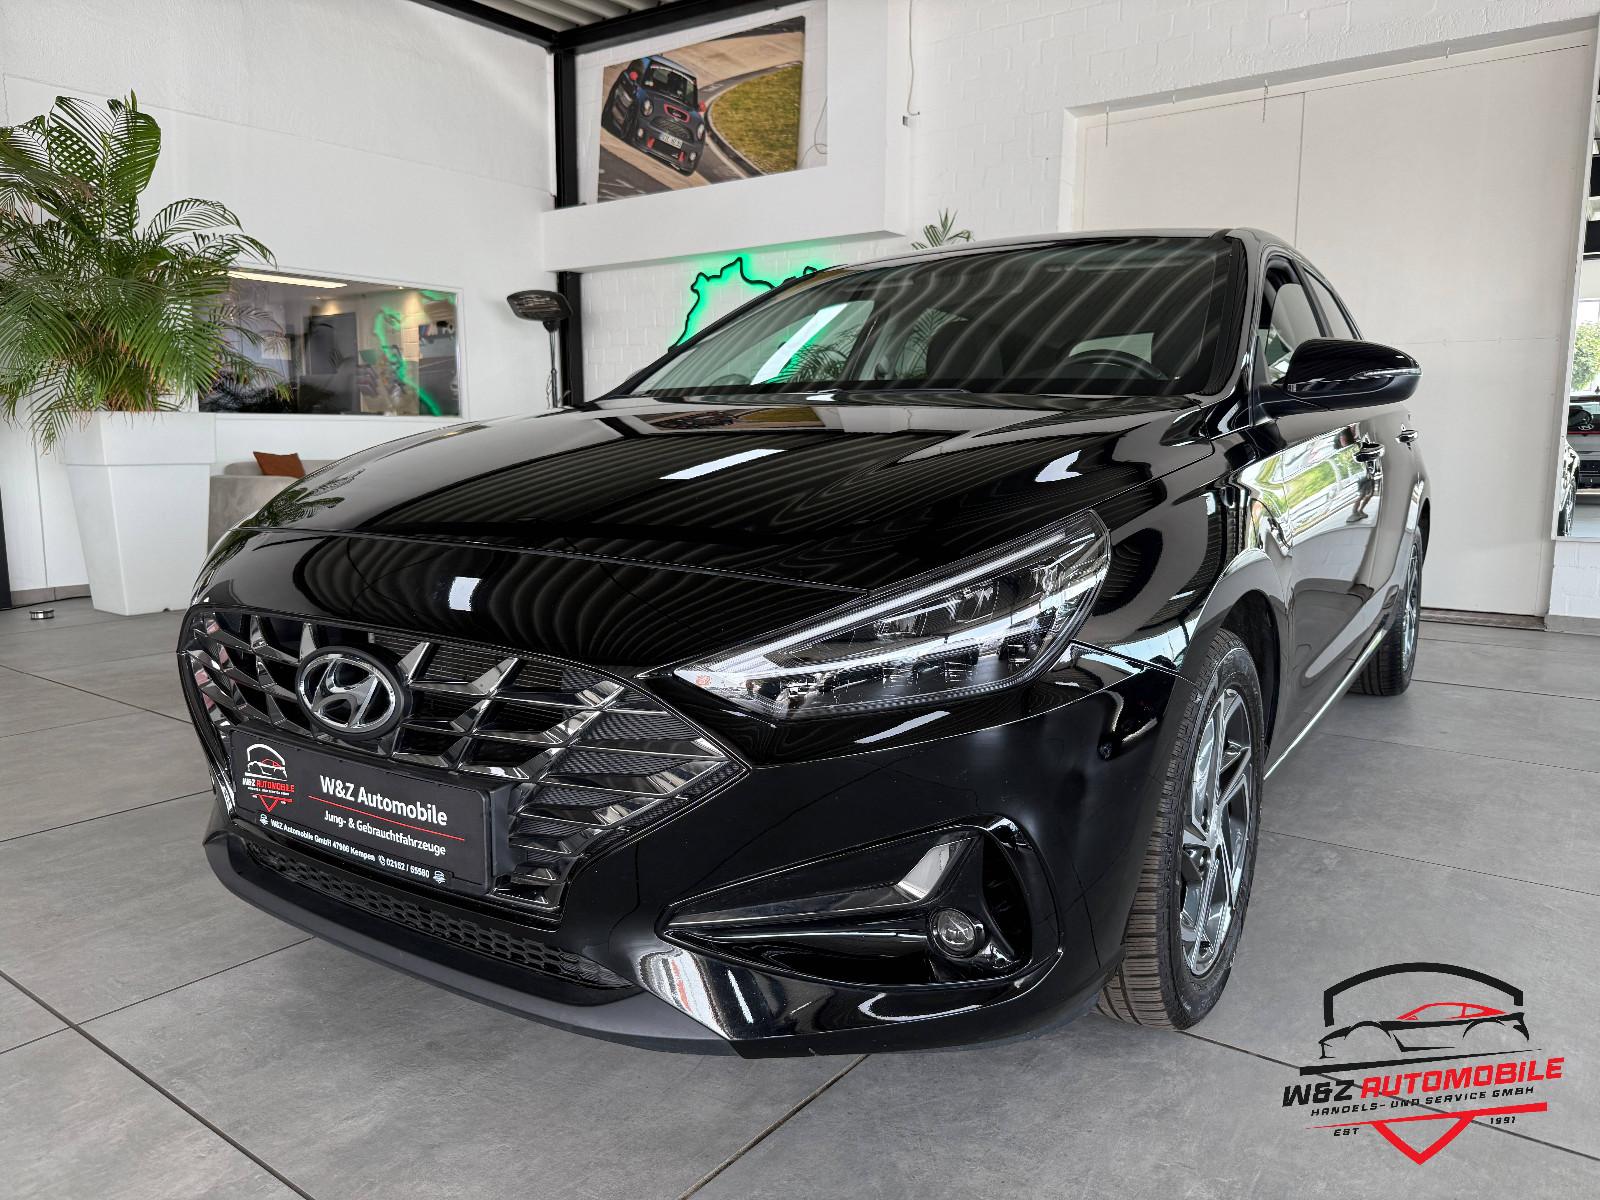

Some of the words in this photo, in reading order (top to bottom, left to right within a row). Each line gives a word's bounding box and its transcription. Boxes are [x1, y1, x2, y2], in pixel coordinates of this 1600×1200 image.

[319, 774, 355, 801] W&Z
[357, 786, 448, 826] Automobile
[283, 824, 314, 841] Automobile
[314, 834, 332, 847] GmbH
[350, 847, 376, 862] Kempen
[324, 810, 347, 828] Jung-
[348, 817, 356, 829] &
[356, 819, 446, 856] Gebrauchtfahrzeuge
